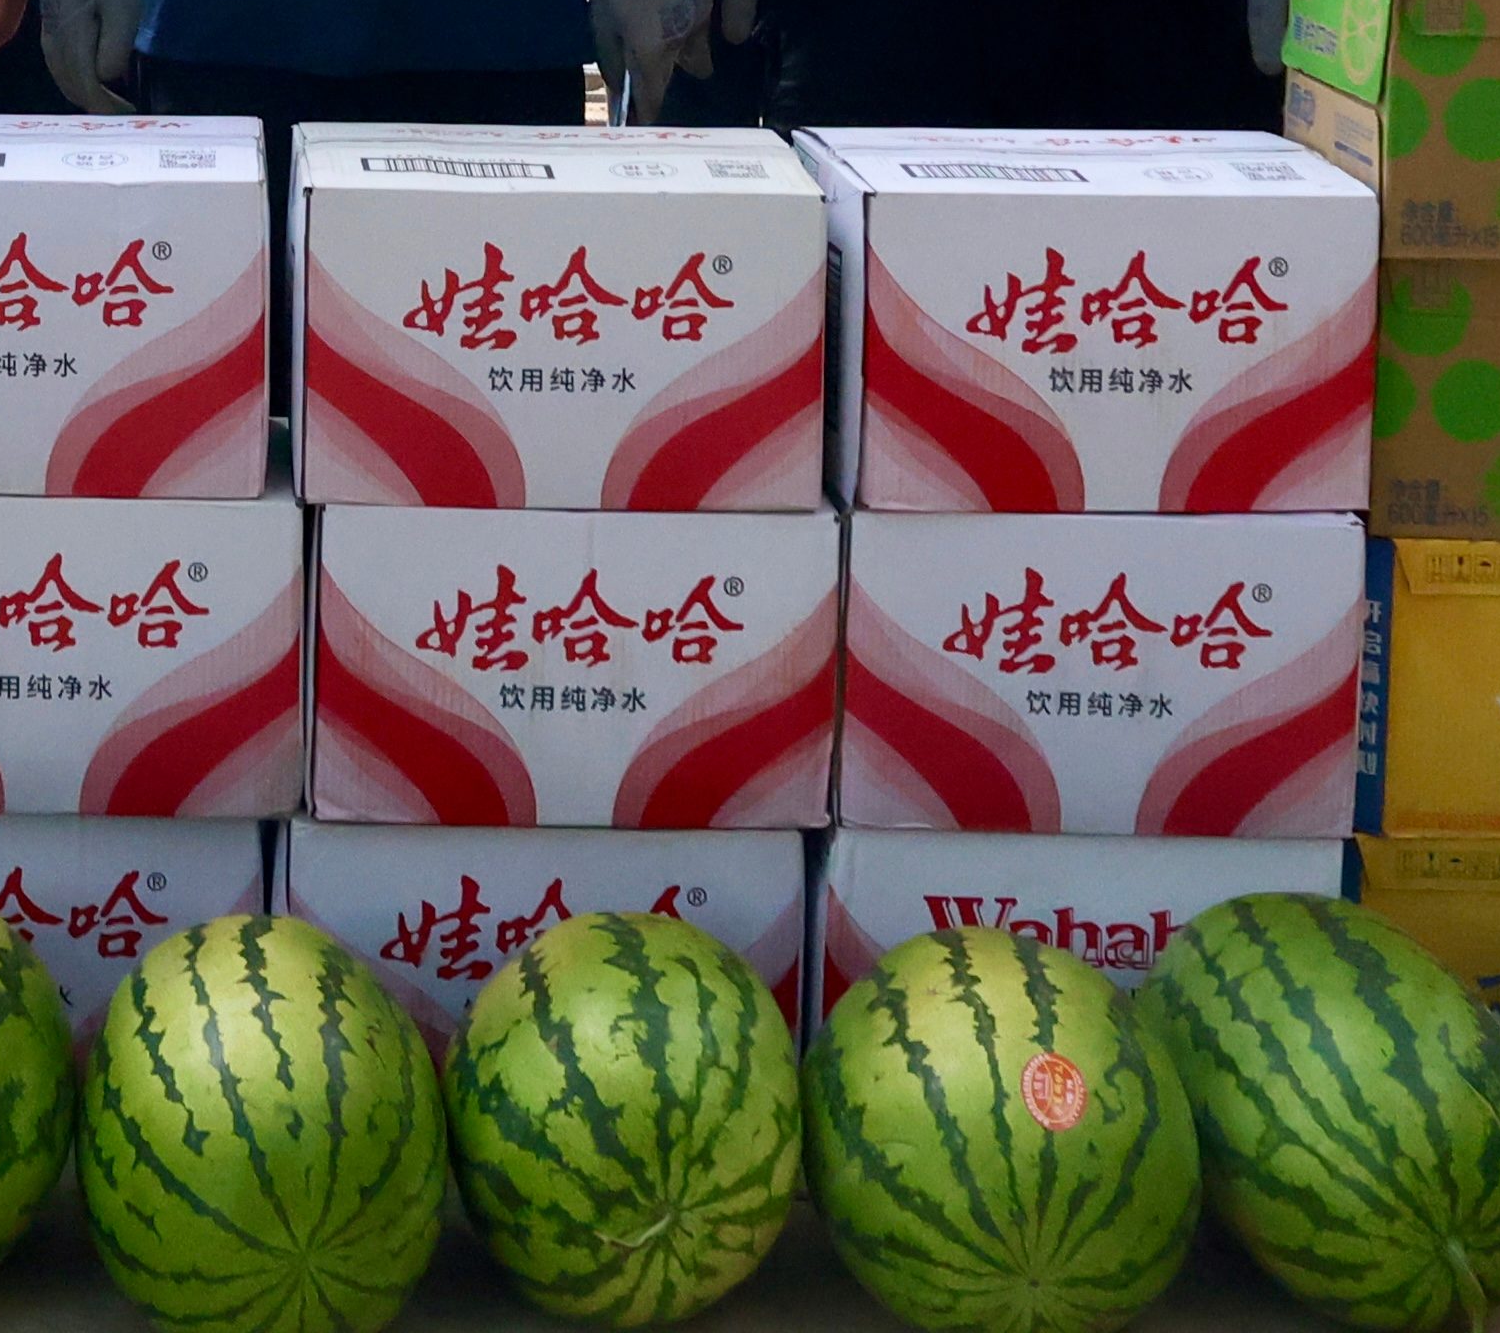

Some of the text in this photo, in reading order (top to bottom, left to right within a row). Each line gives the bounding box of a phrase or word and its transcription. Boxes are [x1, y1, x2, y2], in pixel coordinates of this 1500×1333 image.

[403, 242, 734, 350] 娃哈哈
[966, 247, 1288, 354] 娃哈哈
[488, 365, 637, 394] 饮用纯净水
[1048, 366, 1193, 394] 饮用纯净水
[415, 564, 744, 671] 娃哈哈
[943, 567, 1273, 674] 娃哈哈
[499, 683, 647, 713] 饮用纯净水
[1025, 689, 1174, 718] 饮用纯净水
[379, 874, 682, 980] 娃哈
